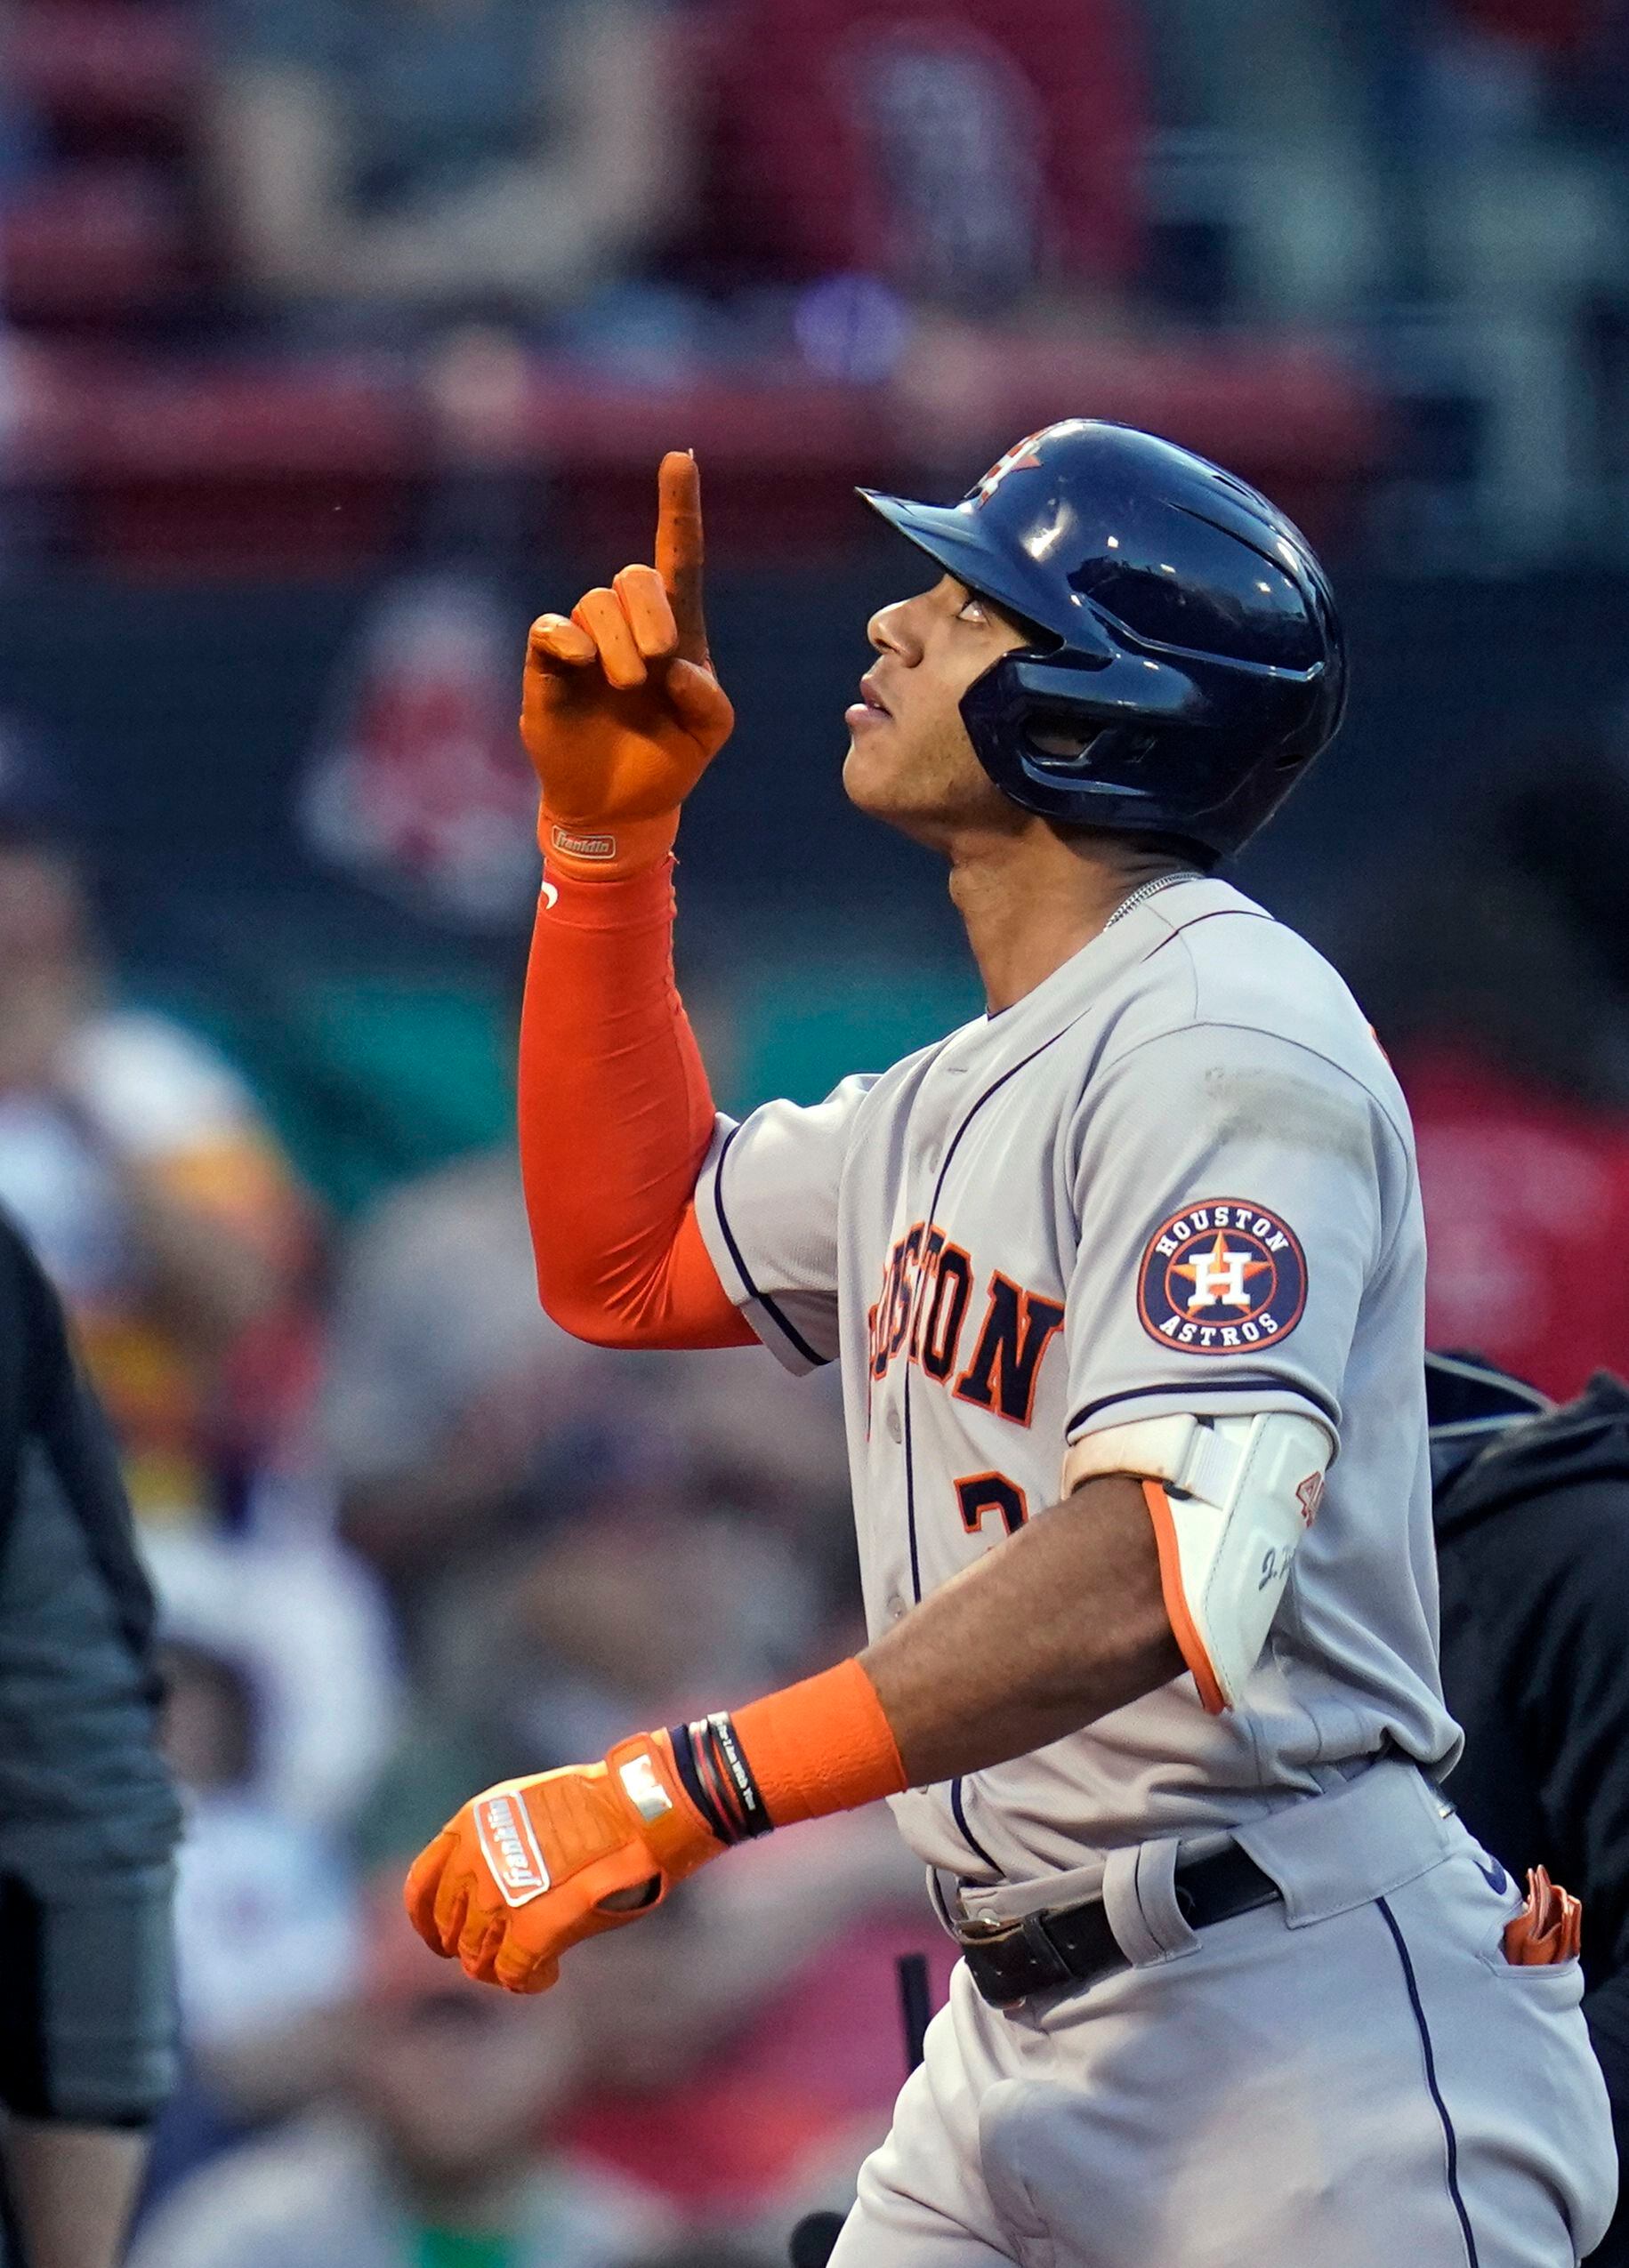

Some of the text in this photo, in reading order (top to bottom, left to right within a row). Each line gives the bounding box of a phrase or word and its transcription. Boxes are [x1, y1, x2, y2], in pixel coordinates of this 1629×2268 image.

[1156, 1207, 1289, 1257] HOUSTON
[1187, 1251, 1253, 1307] H
[1159, 1312, 1278, 1347] ASTROS
